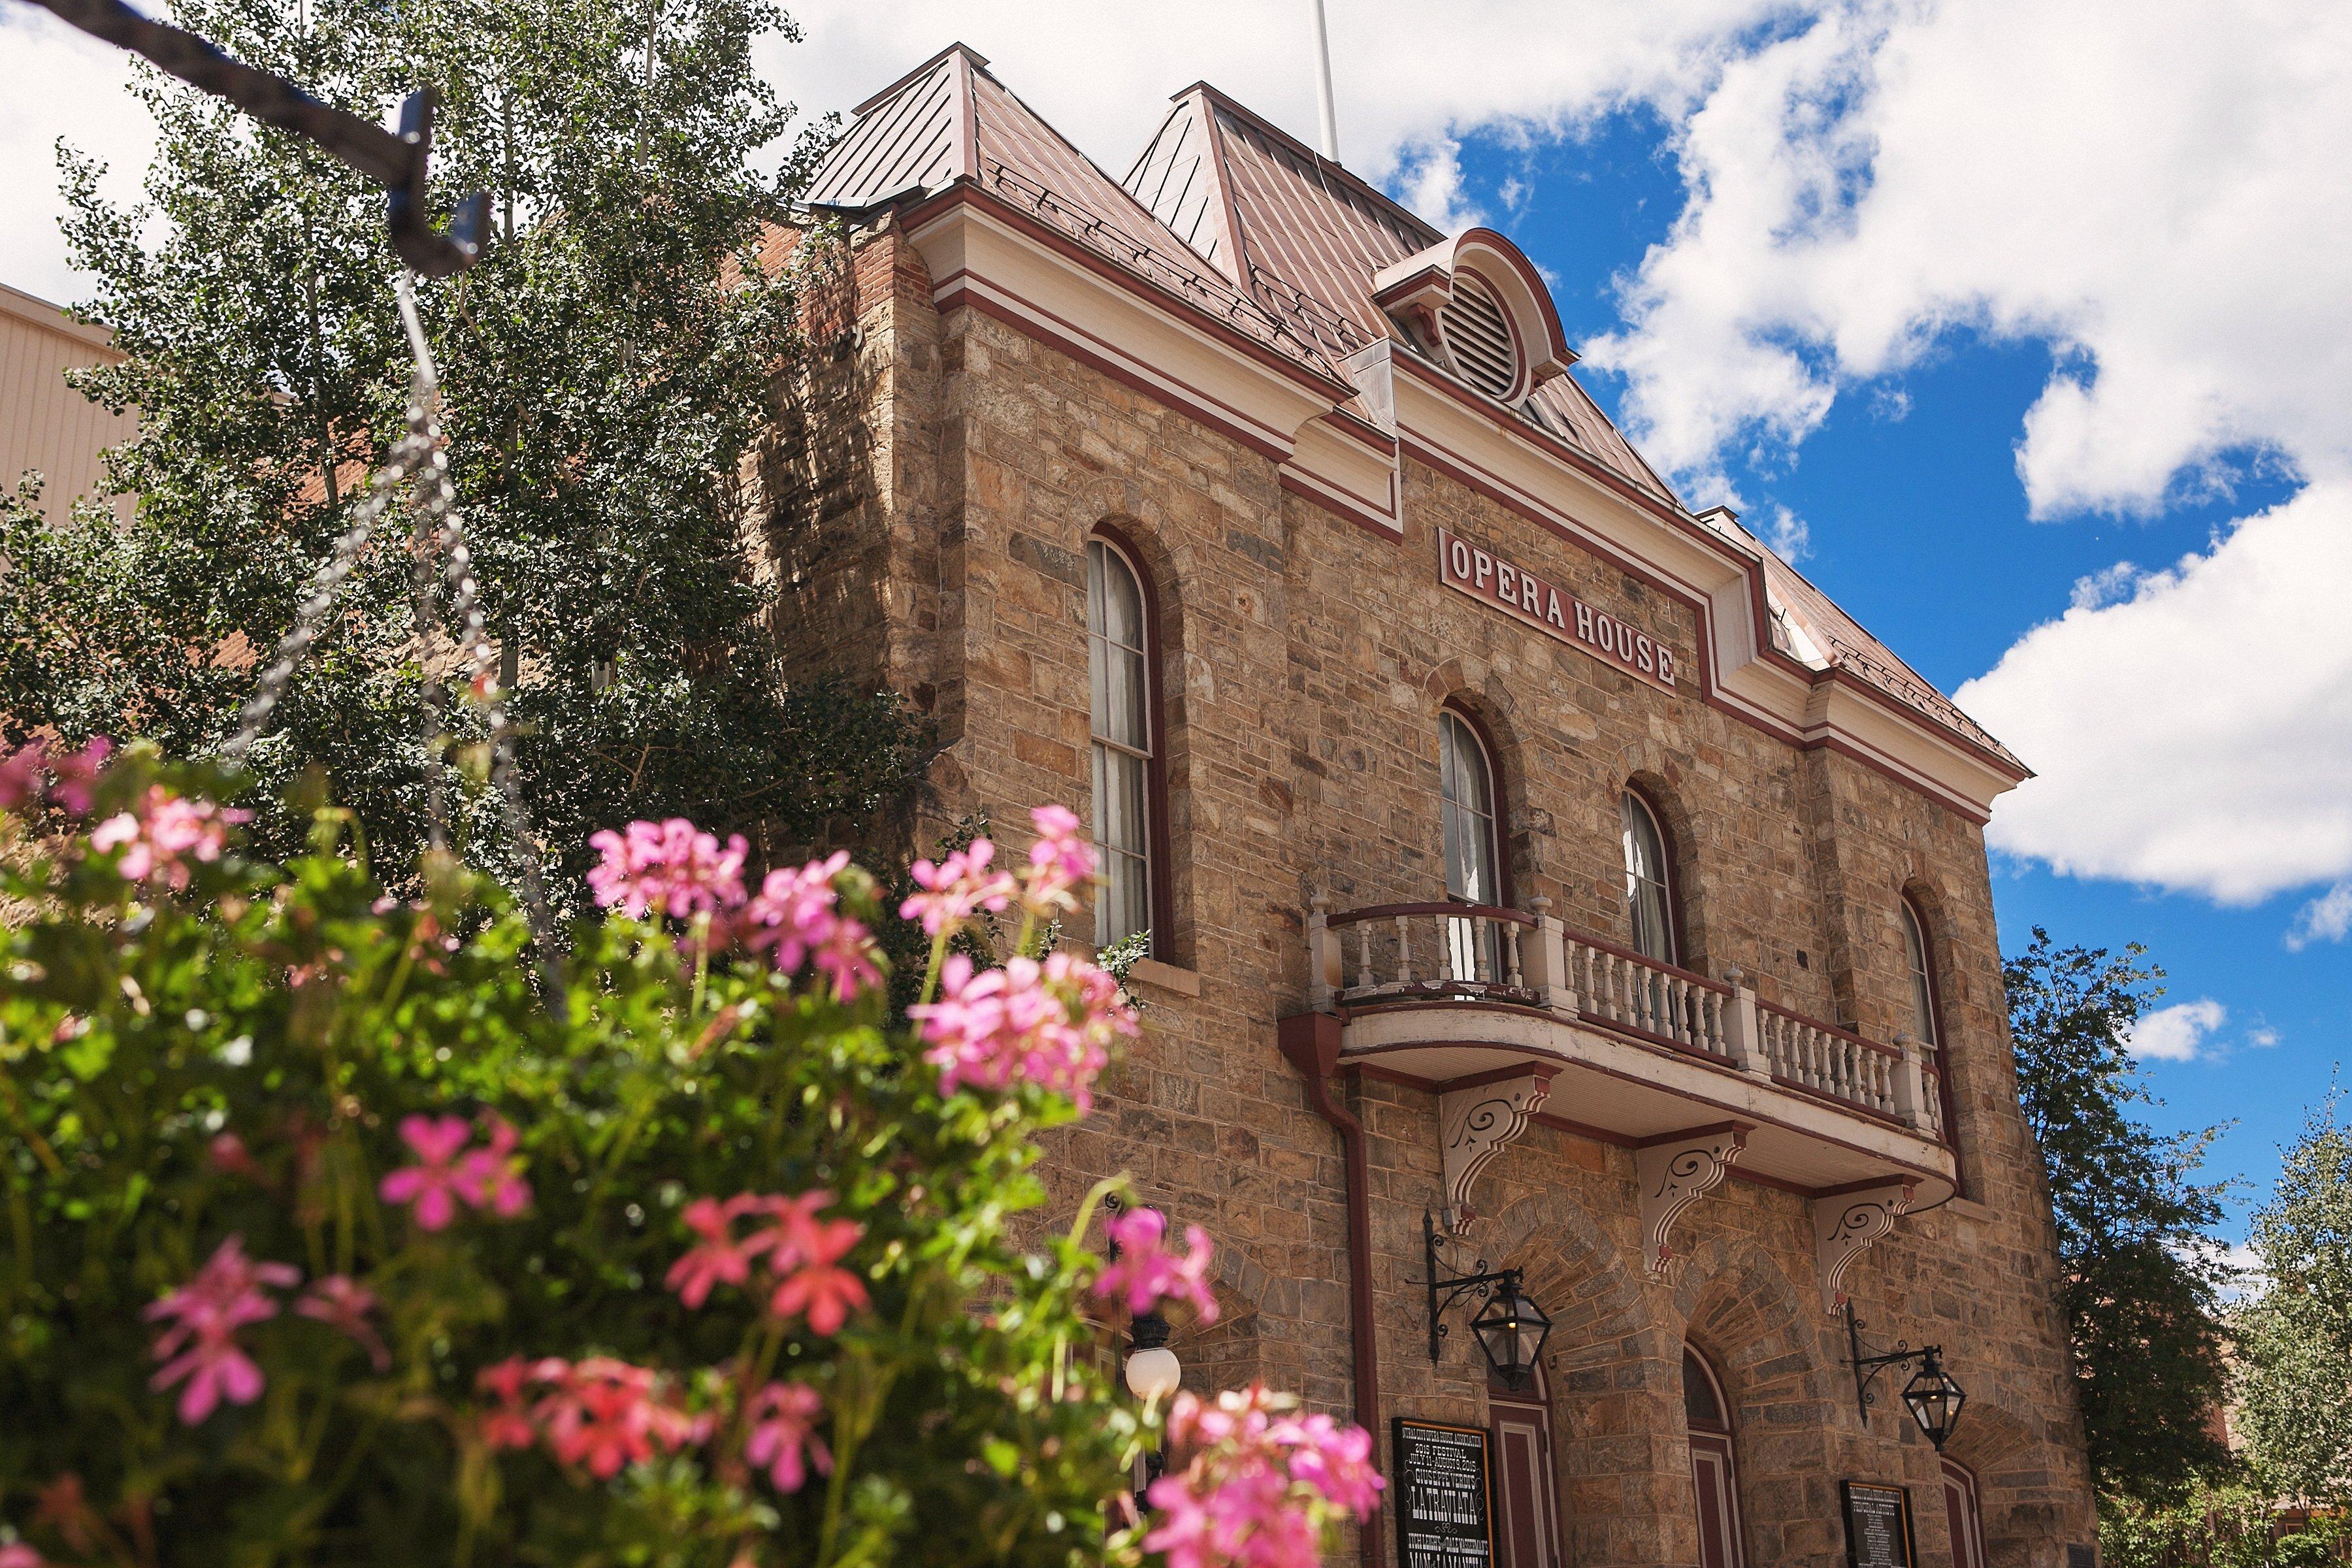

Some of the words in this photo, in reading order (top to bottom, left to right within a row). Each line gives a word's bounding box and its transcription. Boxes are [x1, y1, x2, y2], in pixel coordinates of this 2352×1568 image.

[1452, 540, 1565, 629] OPERA
[1575, 601, 1675, 686] HOUSE
[1426, 1429, 1439, 1442] OPERA
[1439, 1431, 1454, 1445] HOUSE
[1454, 1433, 1482, 1448] ASSOCIATION
[1415, 1443, 1430, 1455] 2015
[1432, 1445, 1467, 1459] FESTIVAL
[1409, 1453, 1425, 1465] JULY
[1462, 1460, 1477, 1473] 2015
[1415, 1467, 1450, 1487] GIUSEPPE
[1450, 1473, 1475, 1490] VERDI'S
[1411, 1486, 1428, 1520] LA
[1426, 1487, 1477, 1525] TRAVIATA
[1446, 1536, 1459, 1553] DALE
